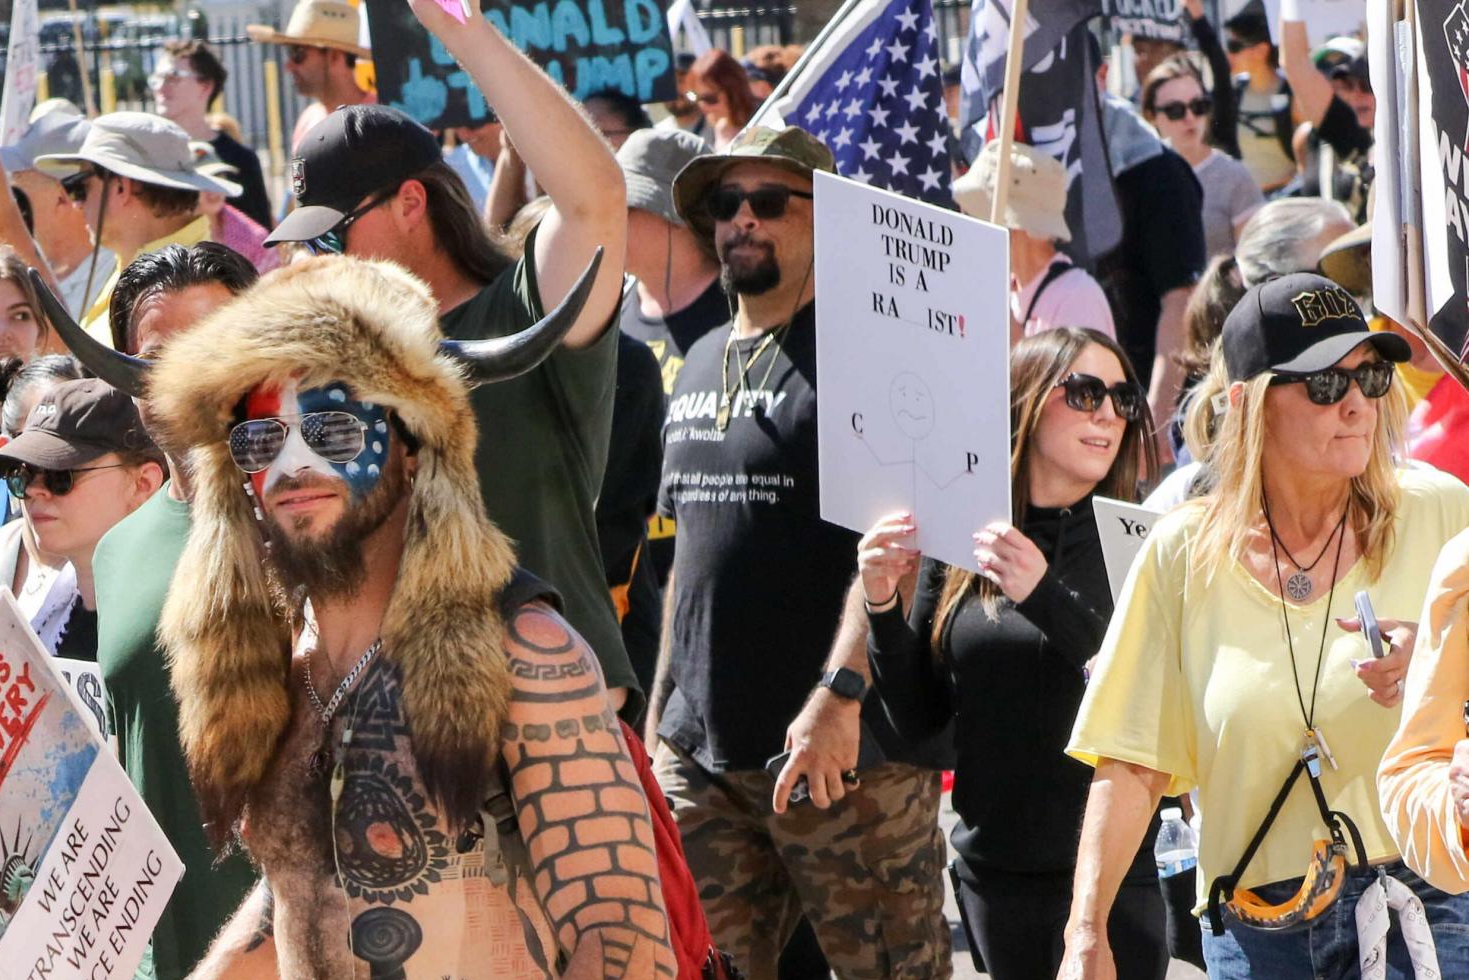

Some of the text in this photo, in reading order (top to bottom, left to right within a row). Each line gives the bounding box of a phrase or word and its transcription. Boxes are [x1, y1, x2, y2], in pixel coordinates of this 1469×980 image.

[446, 48, 670, 120] TUMP
[871, 203, 954, 247] DONALD
[881, 234, 951, 273] TRUMP
[888, 262, 929, 292] IS A
[850, 412, 865, 434] C
[752, 474, 780, 487] equal
[783, 475, 795, 488] in
[965, 451, 980, 473] P
[37, 817, 90, 914] WE ARE
[66, 874, 121, 972] WE ARE
[108, 848, 163, 957] ENDING
